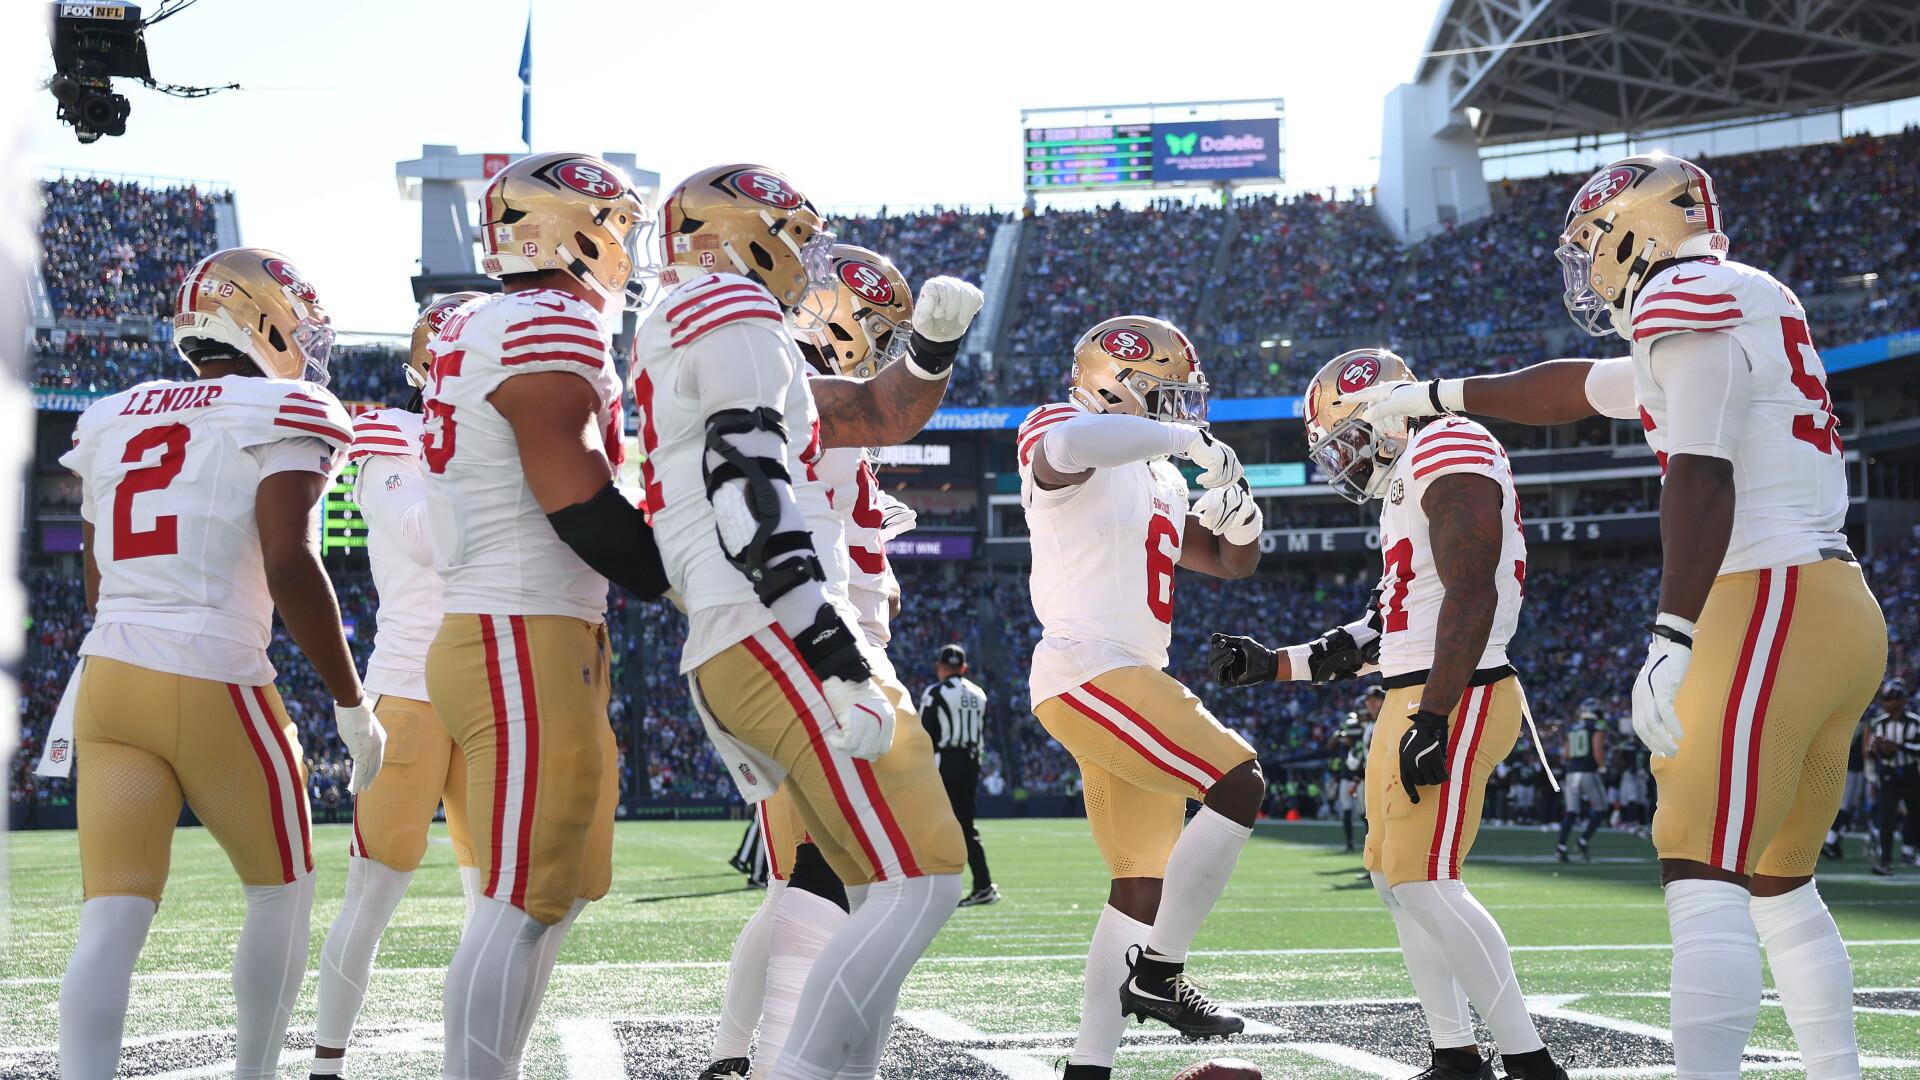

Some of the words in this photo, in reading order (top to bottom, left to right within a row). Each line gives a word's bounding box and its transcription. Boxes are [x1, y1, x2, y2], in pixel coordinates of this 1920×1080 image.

[63, 5, 92, 17] FOX
[96, 7, 122, 18] NFL
[1200, 134, 1265, 153] DaBella
[575, 166, 615, 194] SF
[752, 175, 793, 204] SF
[523, 245, 537, 257] 12
[700, 255, 714, 266] 12
[219, 284, 232, 297] 12
[853, 266, 888, 298] SF
[1112, 332, 1144, 357] SF
[118, 385, 223, 416] LENOIR
[426, 350, 467, 475] 5
[113, 421, 191, 561] 2
[1260, 531, 1336, 554] OME
[1364, 529, 1381, 550] O
[1538, 522, 1601, 542] 12s
[1145, 513, 1180, 625] 6
[1384, 537, 1417, 634] 7
[1568, 728, 1590, 758] 10
